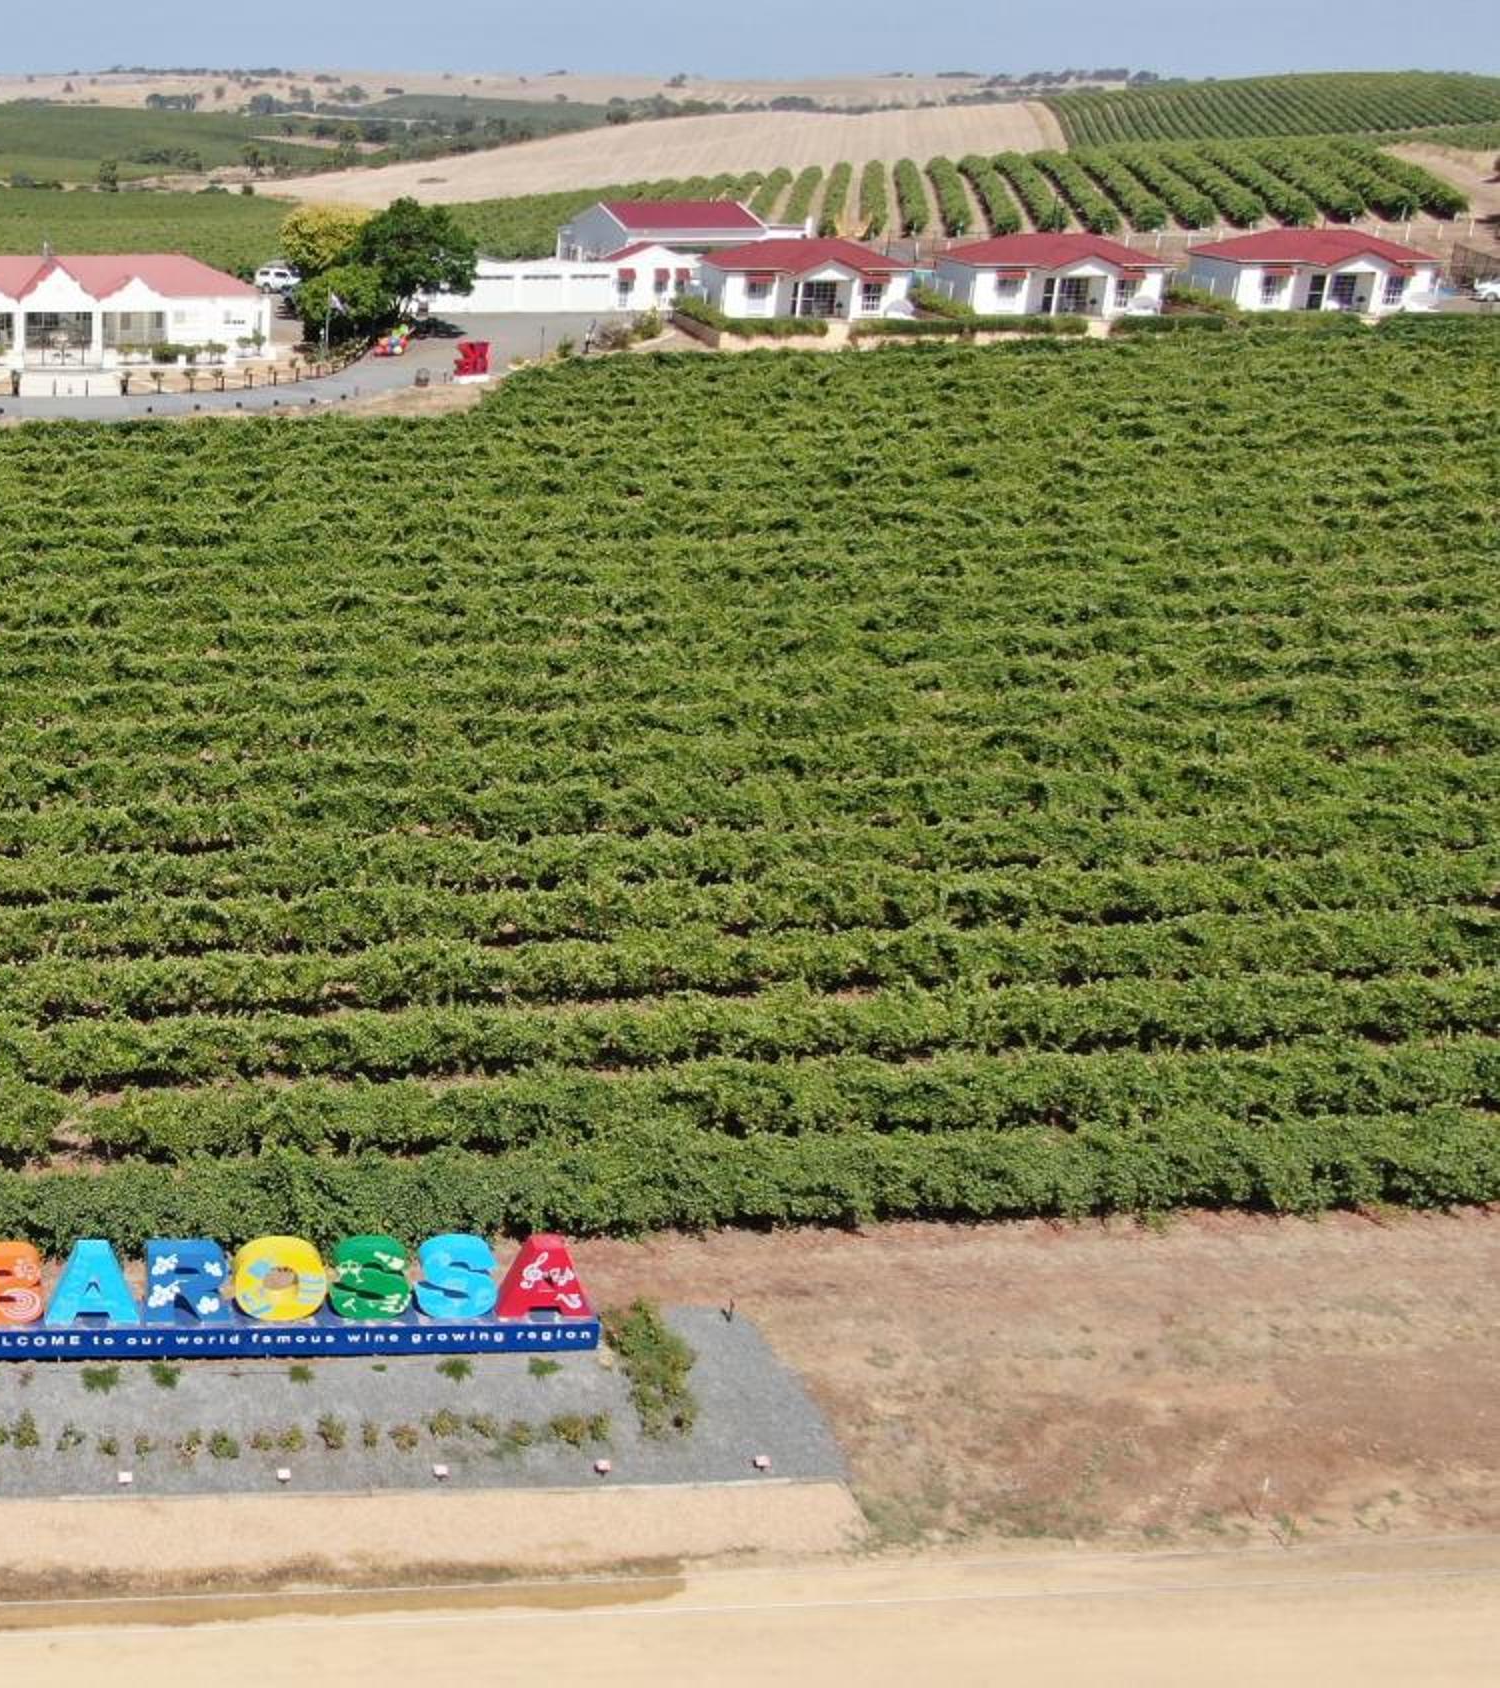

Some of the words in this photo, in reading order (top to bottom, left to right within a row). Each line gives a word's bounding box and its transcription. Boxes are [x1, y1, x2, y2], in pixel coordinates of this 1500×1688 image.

[93, 1335, 115, 1345] to
[126, 1336, 164, 1345] our
[175, 1334, 240, 1345] world
[251, 1333, 335, 1344] famous
[347, 1332, 399, 1343] wine
[411, 1330, 505, 1344] growing
[516, 1329, 591, 1341] region
